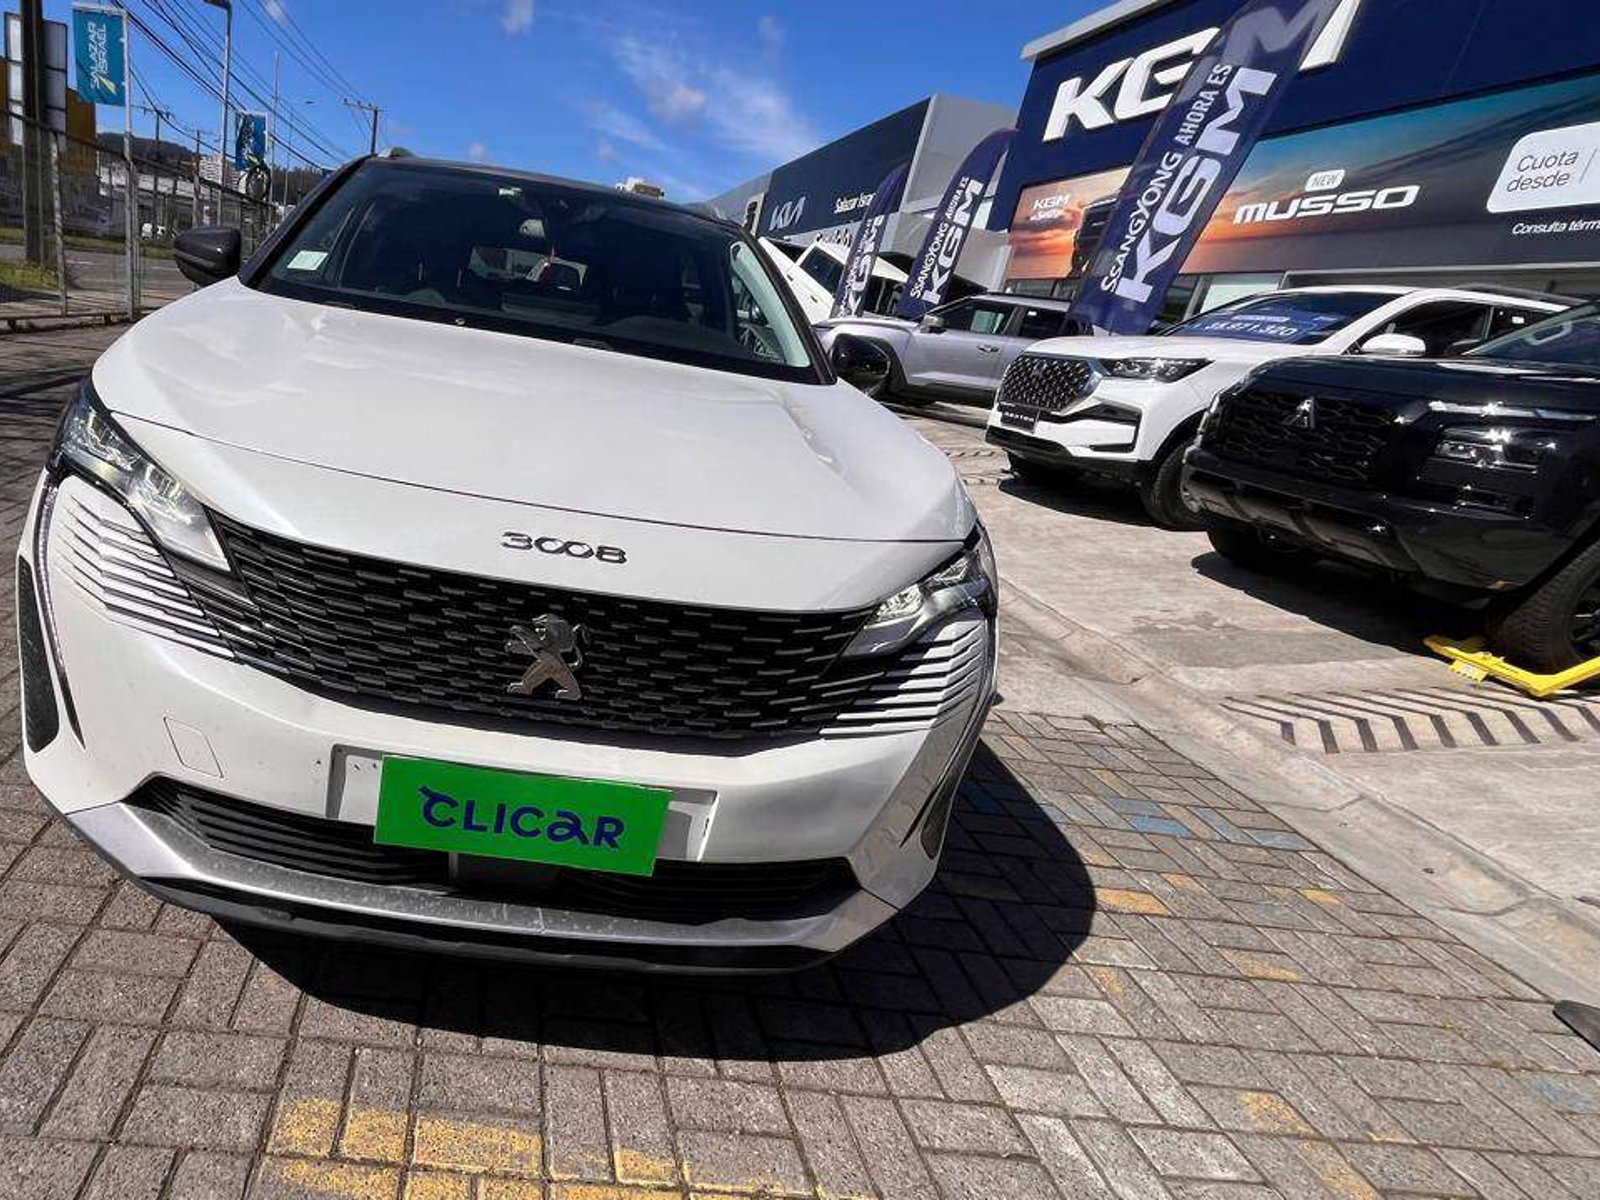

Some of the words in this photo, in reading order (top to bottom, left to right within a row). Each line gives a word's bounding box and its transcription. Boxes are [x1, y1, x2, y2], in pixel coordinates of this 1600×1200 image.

[1101, 151, 1182, 293] SSANGYONG
[1174, 90, 1219, 146] AHORA
[1209, 63, 1233, 85] ES
[1517, 151, 1579, 172] Cuota
[1115, 67, 1277, 303] KGM
[1311, 174, 1341, 187] NEW
[1506, 170, 1571, 192] desde
[1033, 194, 1070, 210] KGM
[1233, 185, 1420, 225] MUSSO
[921, 179, 984, 304] KGM
[1512, 222, 1567, 234] Consulta
[910, 222, 949, 299] SSANGYONG
[500, 531, 628, 564] 3008
